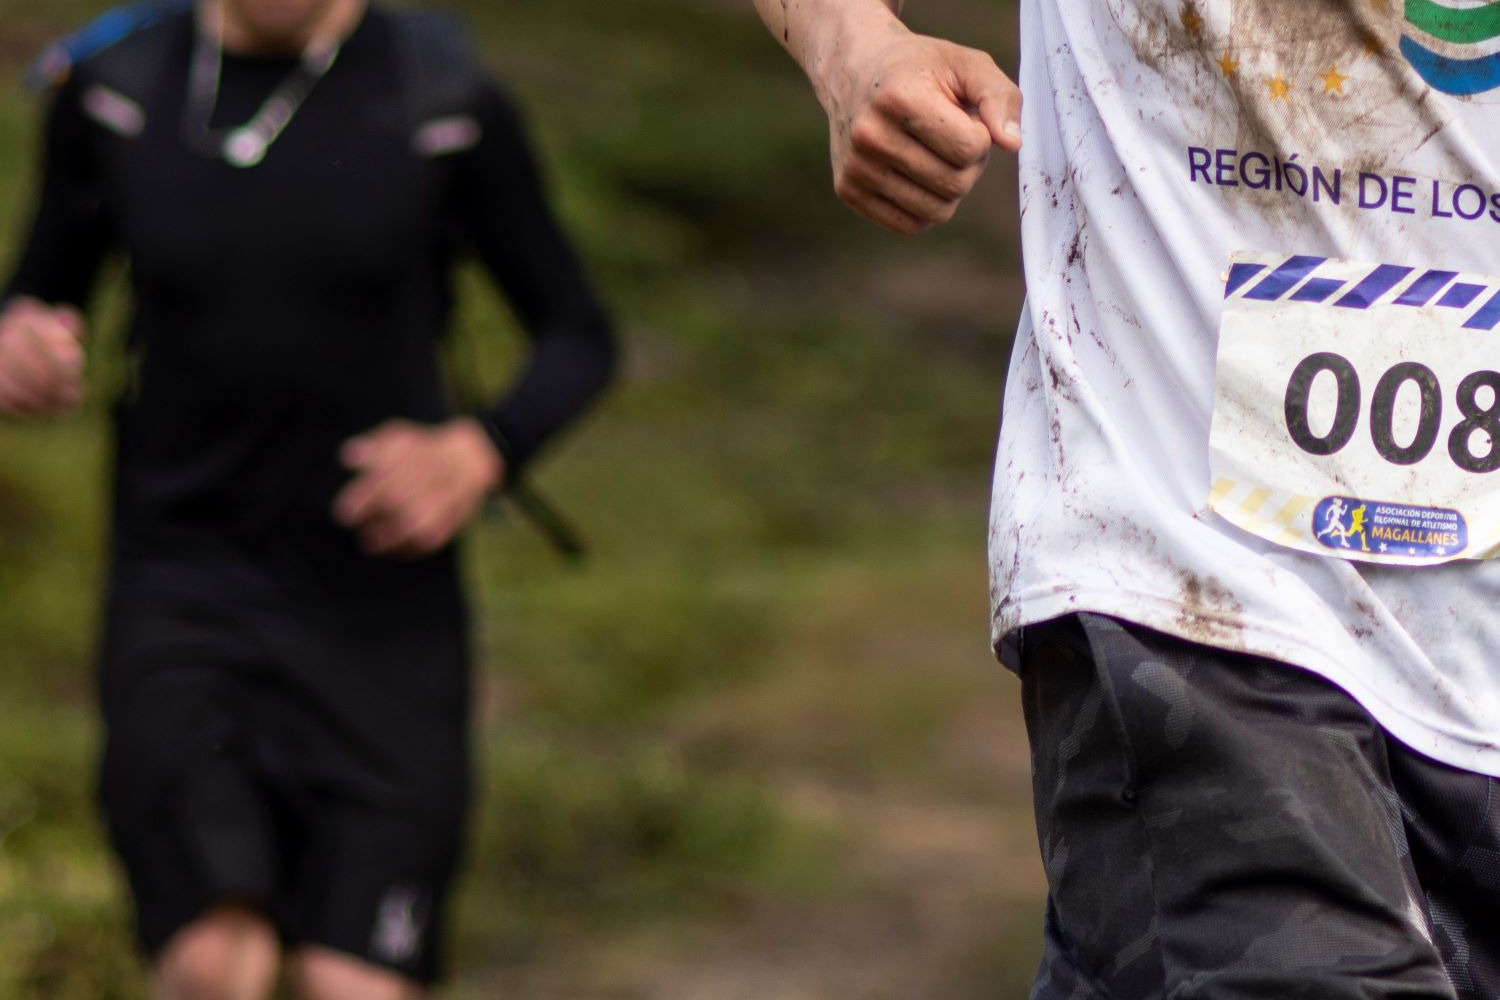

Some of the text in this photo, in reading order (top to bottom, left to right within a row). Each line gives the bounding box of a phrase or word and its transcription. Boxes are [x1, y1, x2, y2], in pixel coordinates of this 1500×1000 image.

[1187, 146, 1341, 206] REGIÓN
[1358, 172, 1417, 214] DE
[1375, 506, 1458, 521] ASOCIACIÓN DEPORTIVA
[1374, 515, 1458, 531] REGIONAL DE ATLETISMO
[1371, 526, 1459, 546] MAGALLANES
